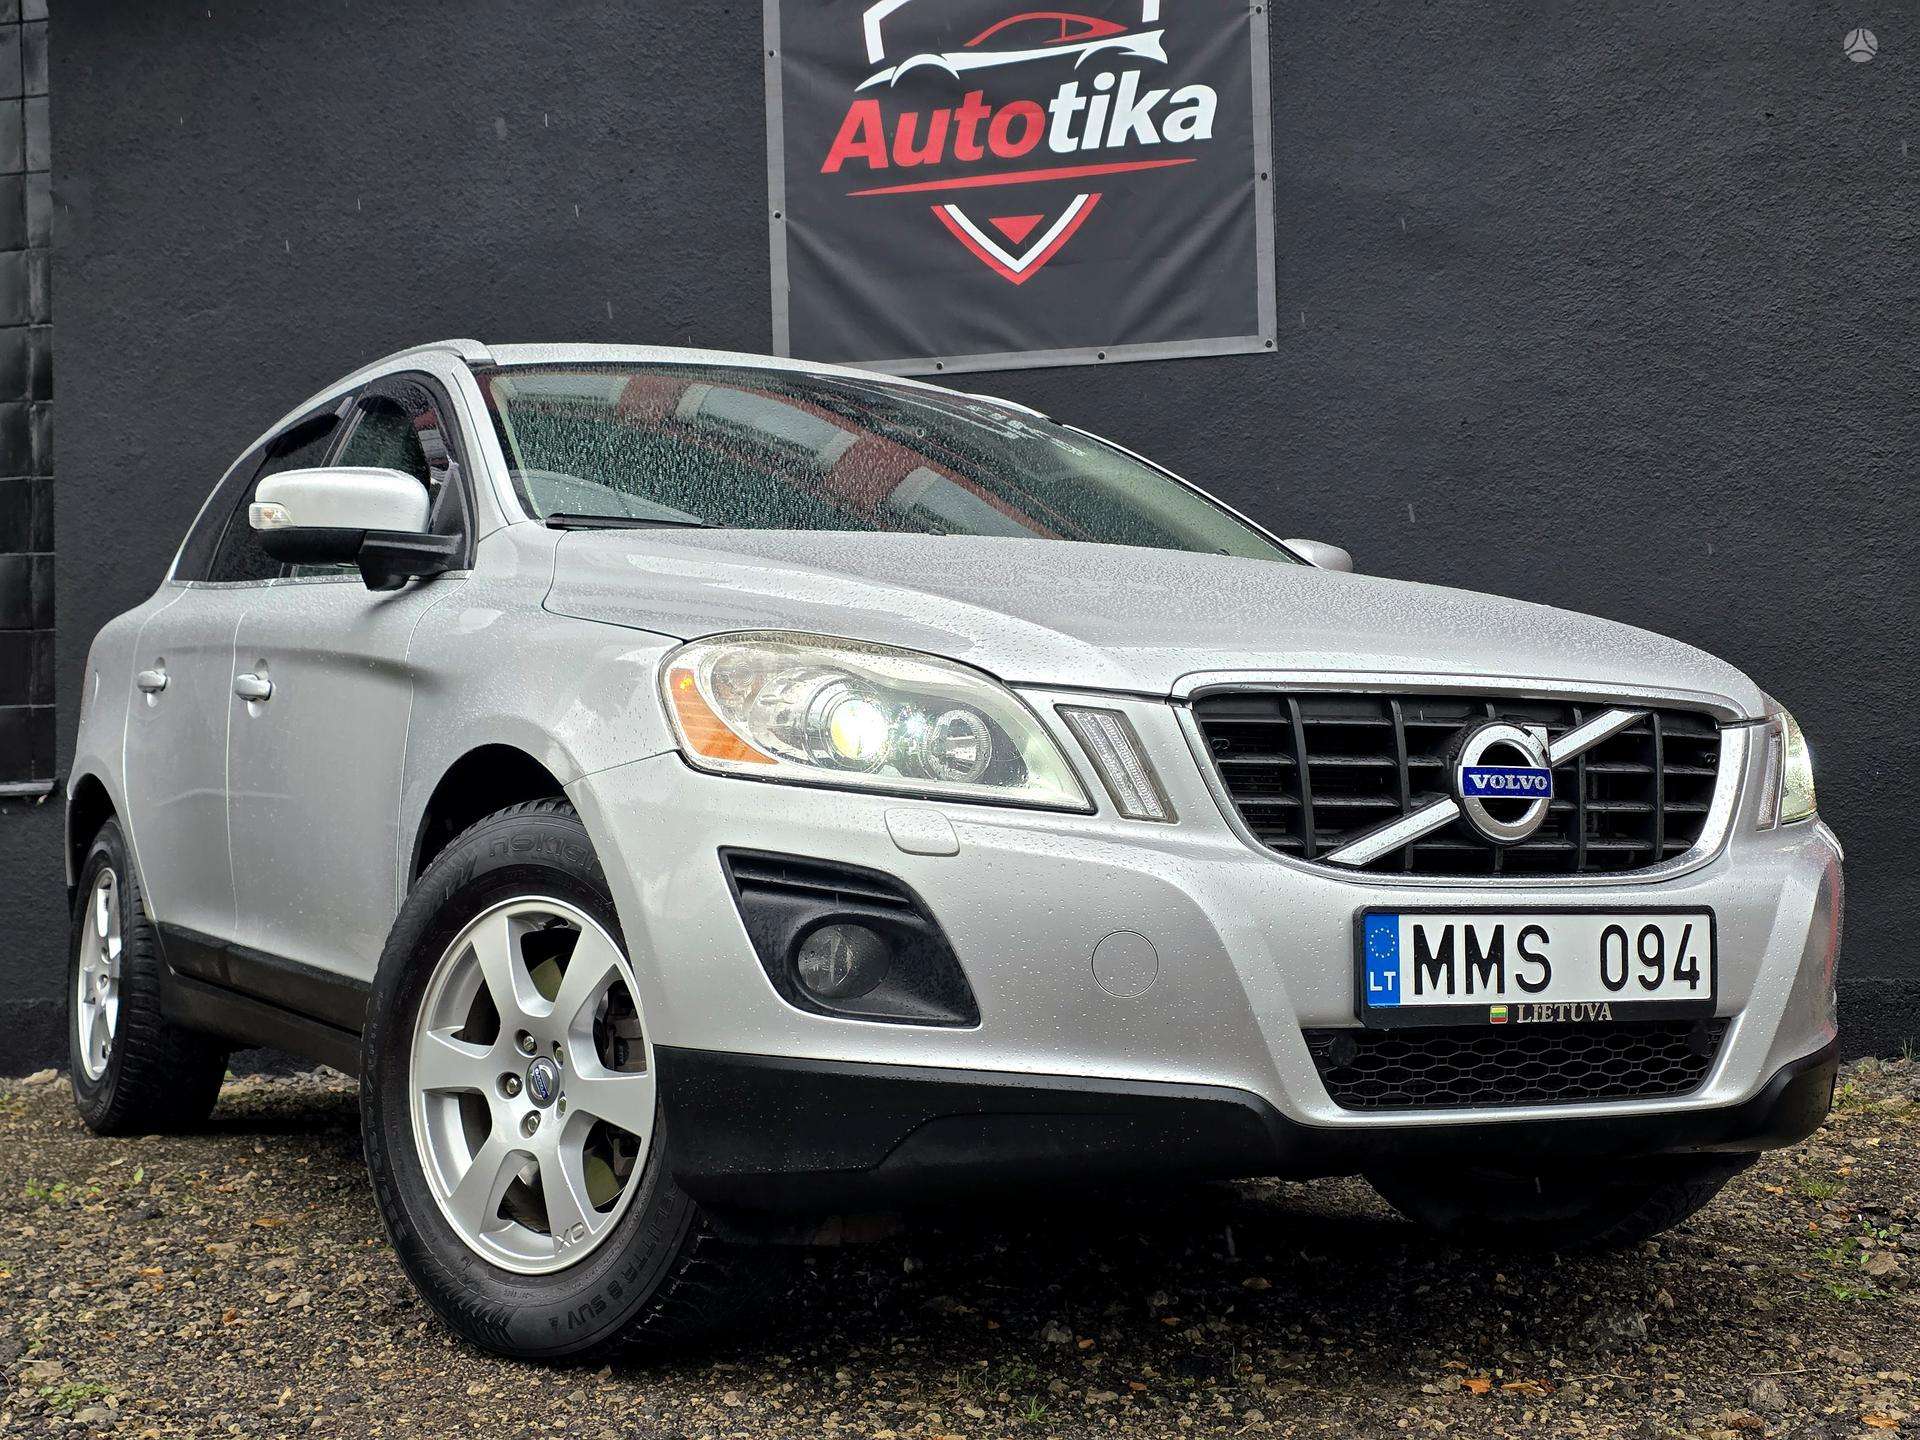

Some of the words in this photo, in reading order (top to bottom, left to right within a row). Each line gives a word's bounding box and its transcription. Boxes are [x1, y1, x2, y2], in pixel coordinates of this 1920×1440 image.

[821, 71, 1218, 174] Autotika
[1469, 774, 1548, 790] VOLVO
[1413, 924, 1552, 995] MMS
[1600, 923, 1700, 992] 094
[1369, 971, 1397, 992] LT
[1516, 1002, 1613, 1024] LIETUVA
